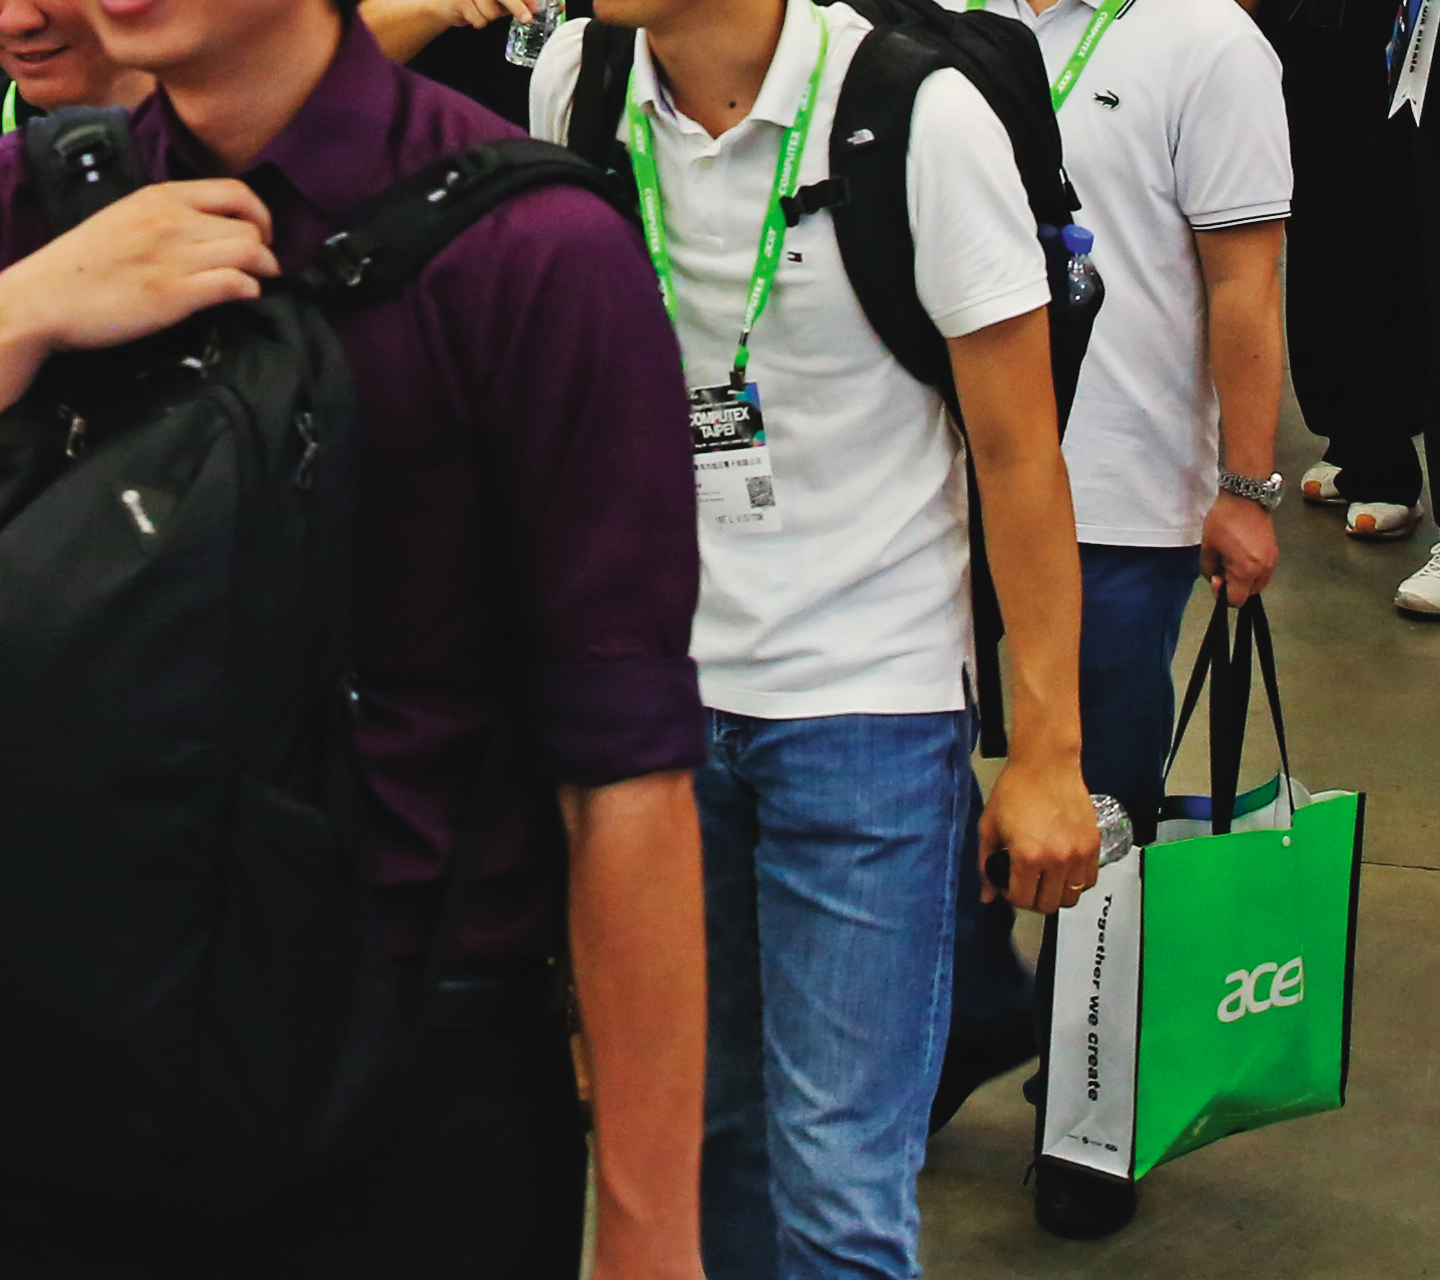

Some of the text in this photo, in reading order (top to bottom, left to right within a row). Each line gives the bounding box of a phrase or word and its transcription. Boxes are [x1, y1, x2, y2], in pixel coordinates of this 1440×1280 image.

[779, 130, 799, 196] COMPUTEX
[699, 423, 736, 439] TAIPEI
[1088, 1000, 1102, 1027] we
[1216, 953, 1304, 1024] ace
[1086, 1032, 1100, 1103] create
